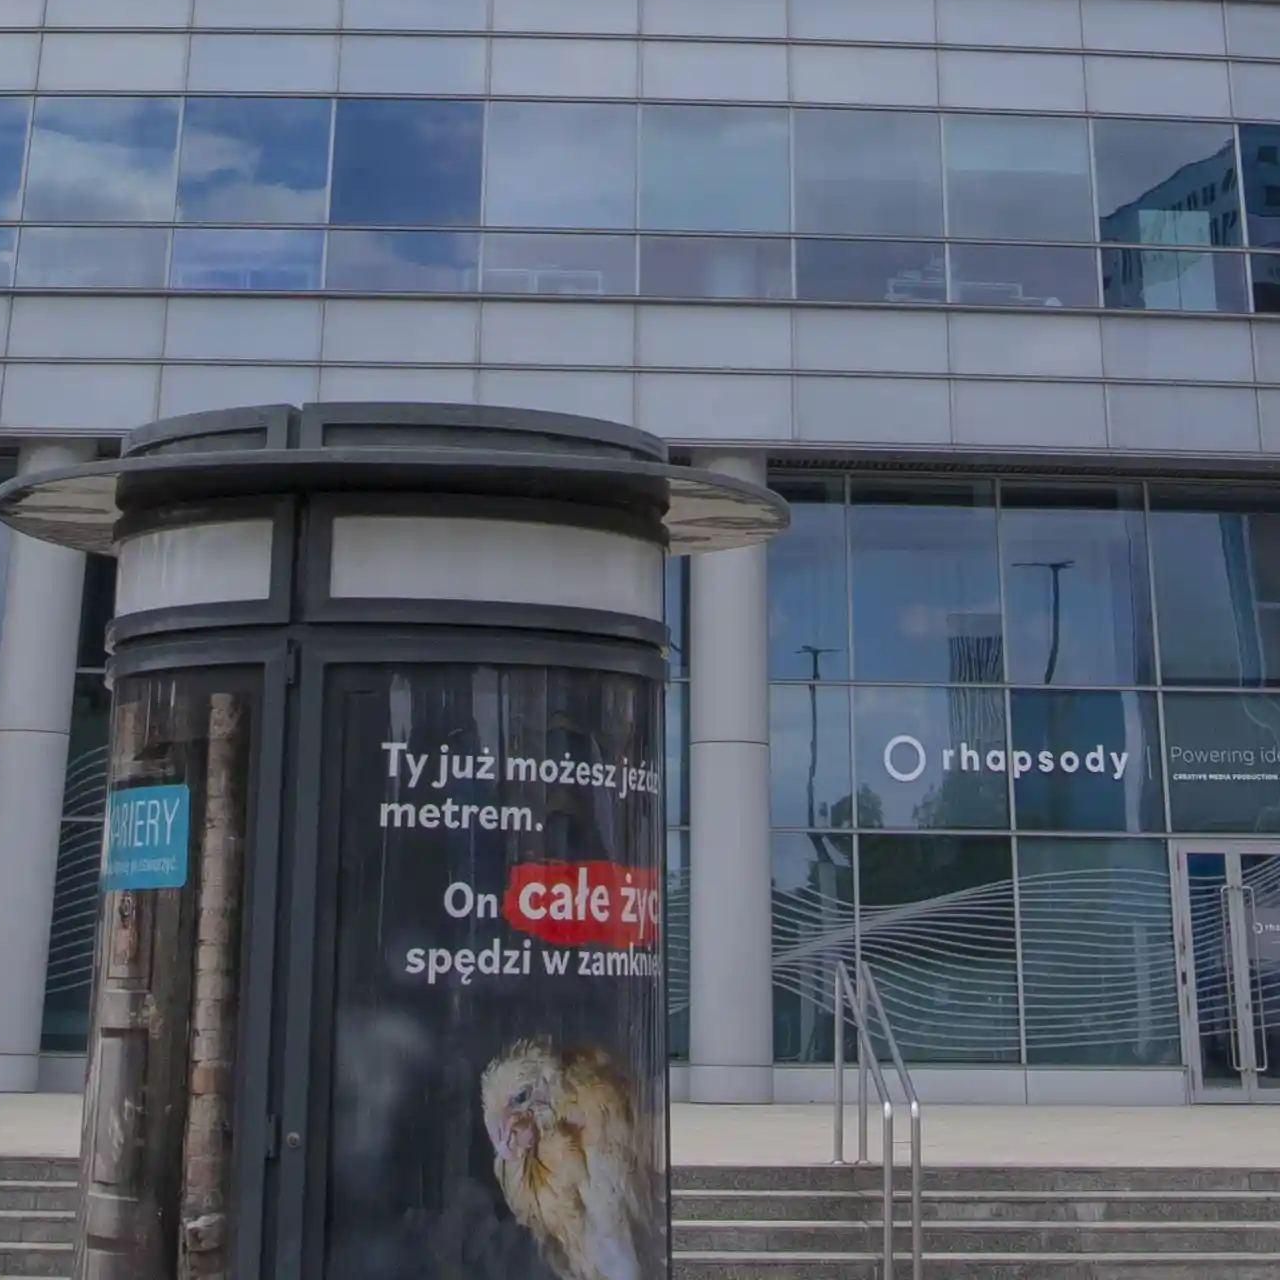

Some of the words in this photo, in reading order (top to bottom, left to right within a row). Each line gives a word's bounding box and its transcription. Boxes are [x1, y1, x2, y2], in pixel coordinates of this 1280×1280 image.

[380, 742, 428, 788] Ty
[432, 744, 495, 788] już
[506, 752, 616, 788] możesz
[942, 742, 1129, 780] rhapsody
[1170, 746, 1254, 766] Powering
[1209, 773, 1230, 781] MEDIA
[379, 798, 543, 831] metrem.
[443, 881, 498, 919] On
[519, 867, 610, 922] całe
[405, 938, 532, 985] spędzi
[542, 948, 570, 976] w
